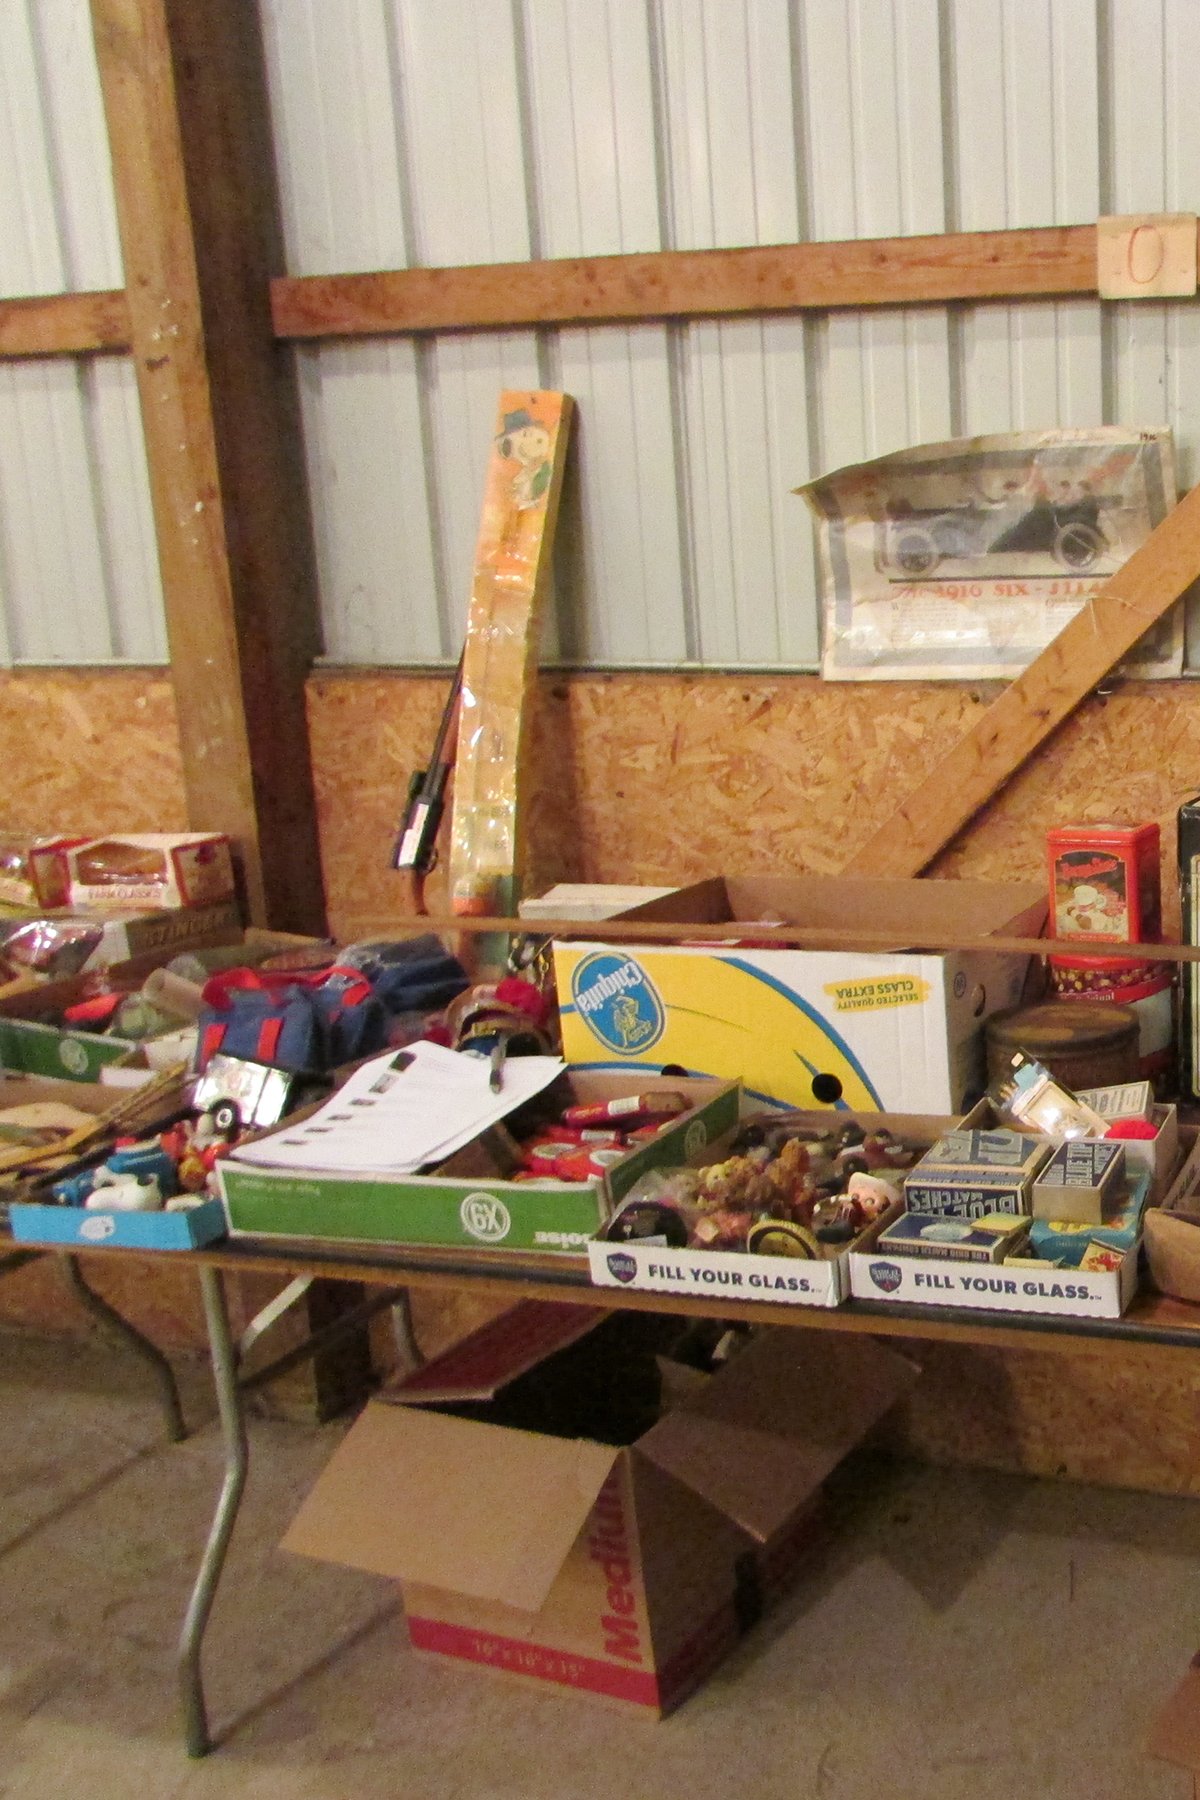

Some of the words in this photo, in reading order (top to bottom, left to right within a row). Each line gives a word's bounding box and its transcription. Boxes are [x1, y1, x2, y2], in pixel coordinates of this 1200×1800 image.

[993, 583, 1028, 596] SIX
[576, 960, 643, 1017] Chiquita
[836, 984, 875, 999] EXTRA
[877, 980, 914, 994] CLASS
[837, 997, 875, 1010] QUALITY
[877, 992, 919, 1005] SELECTED
[908, 1189, 984, 1213] MATCHES
[648, 1263, 686, 1281] FILL
[690, 1267, 743, 1286] YOUR
[914, 1272, 955, 1289] FILL
[959, 1276, 1017, 1295] YOUR
